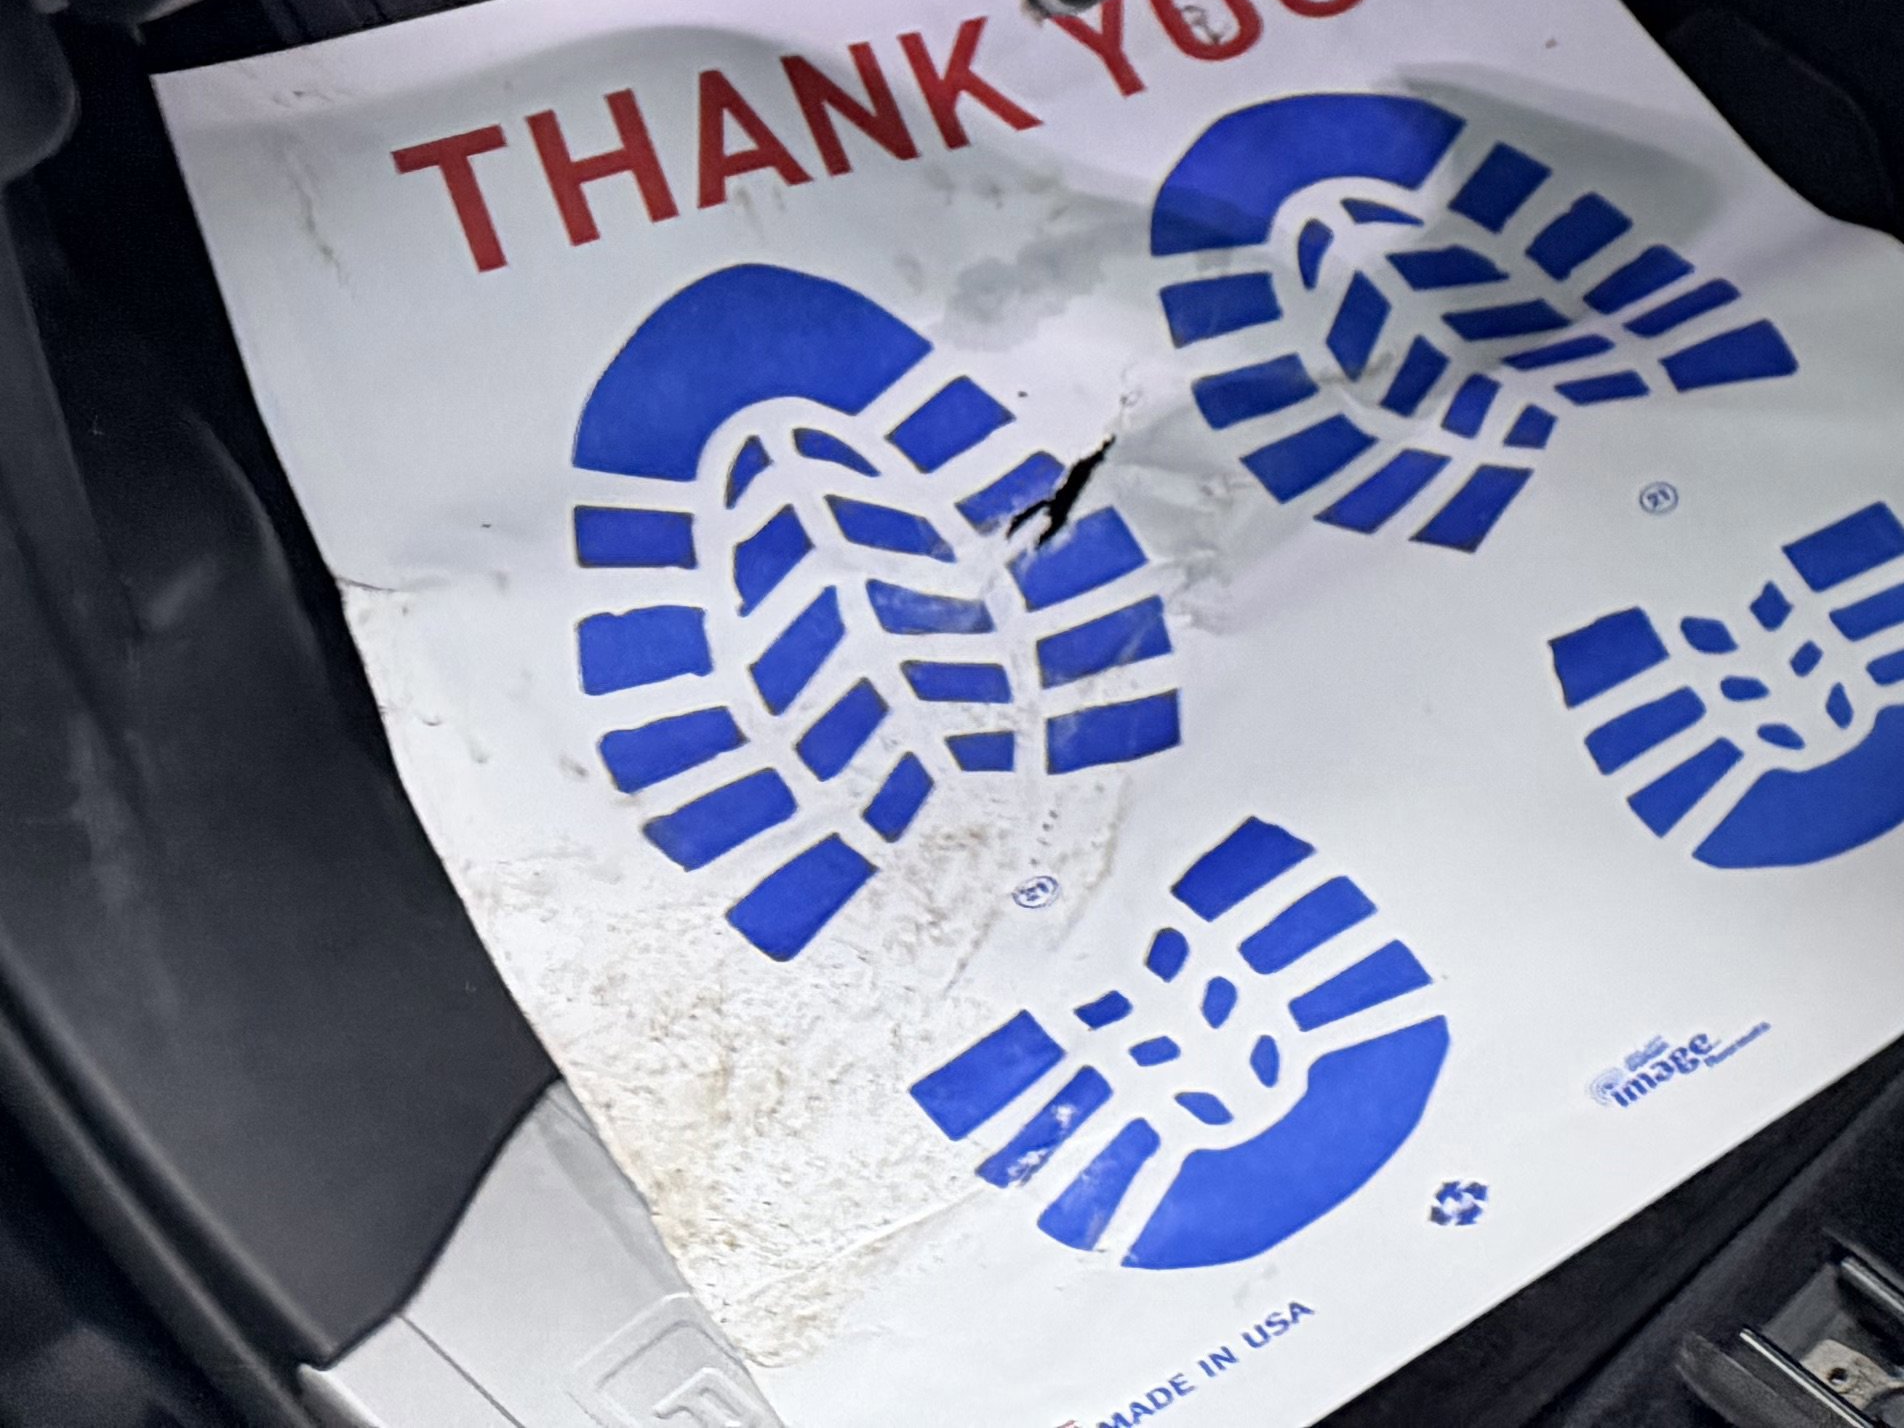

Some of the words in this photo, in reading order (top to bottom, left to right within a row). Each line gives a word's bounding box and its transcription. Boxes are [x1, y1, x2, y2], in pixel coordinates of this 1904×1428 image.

[391, 14, 1044, 273] THANK
[1197, 1345, 1239, 1378] IN
[1241, 1300, 1316, 1349] USA
